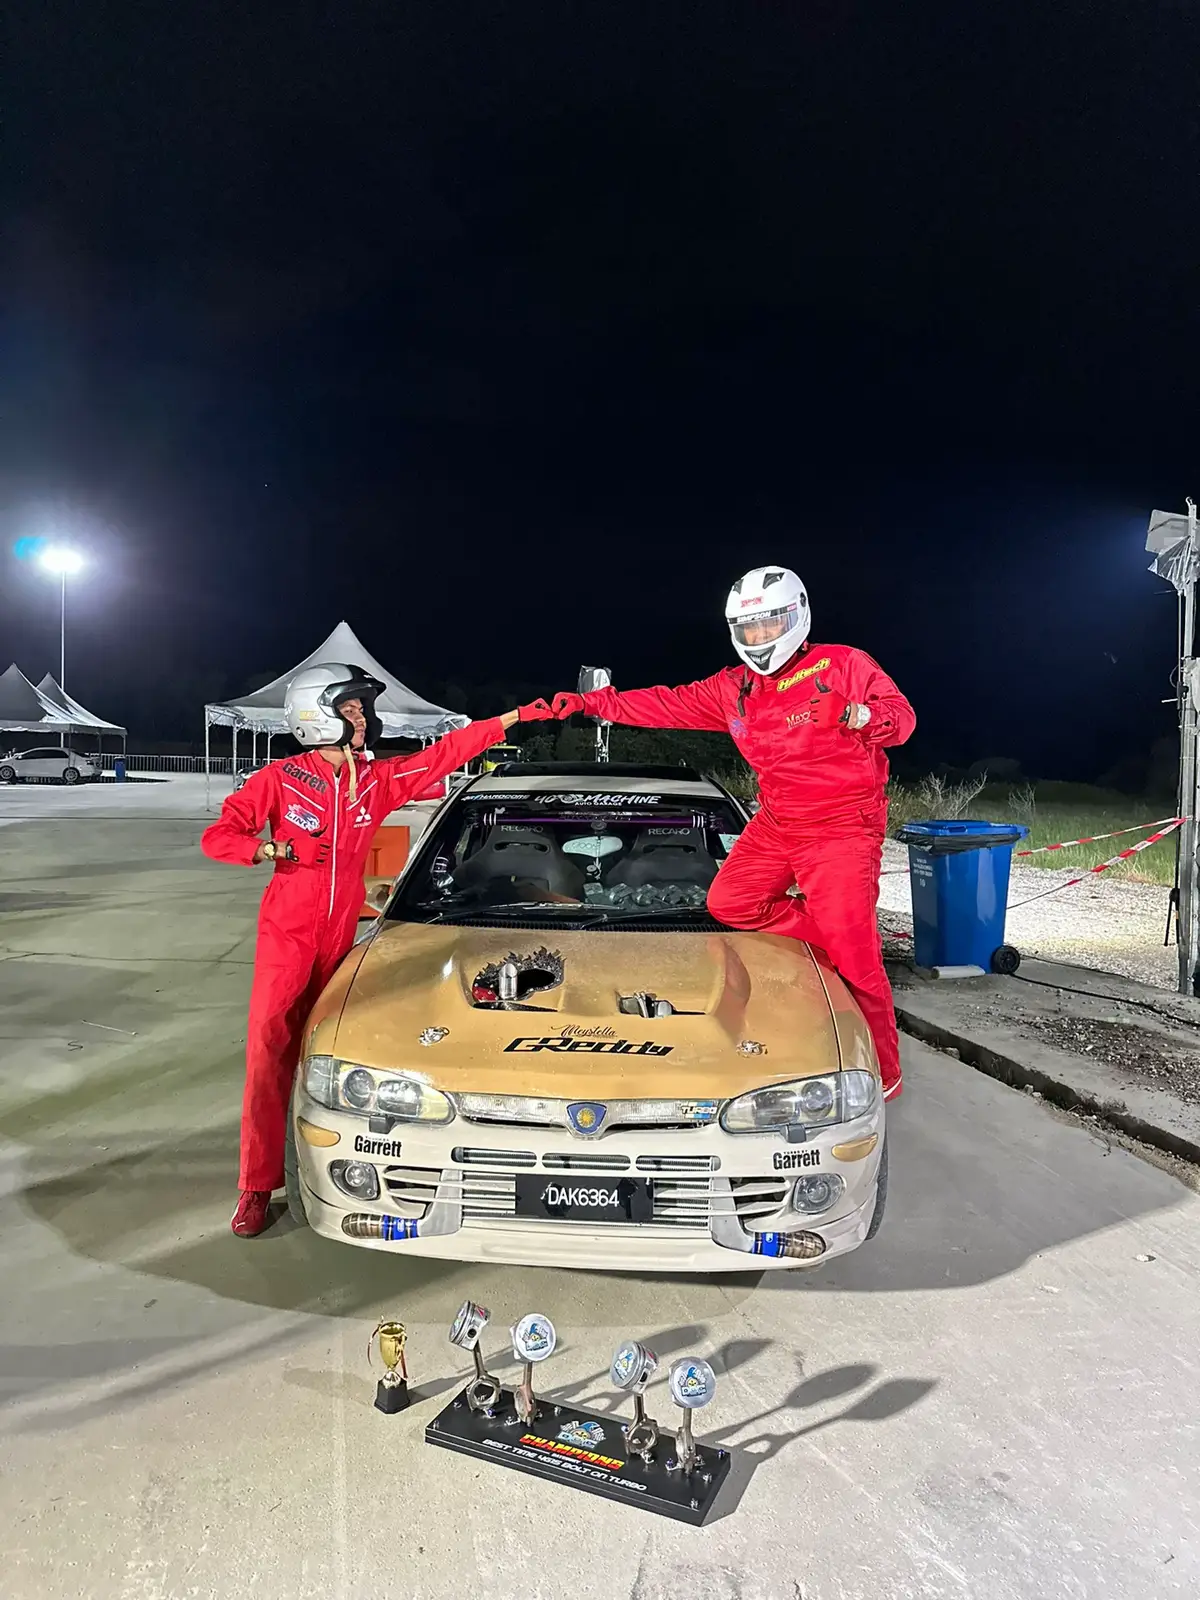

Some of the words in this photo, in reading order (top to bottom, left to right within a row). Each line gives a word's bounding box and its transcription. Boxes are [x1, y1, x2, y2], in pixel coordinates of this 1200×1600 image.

[737, 611, 771, 622] SIMPSON
[584, 793, 661, 804] MACHINE
[501, 825, 544, 833] RECARO
[648, 827, 690, 835] RECARO
[551, 1024, 637, 1038] Meystella
[503, 1037, 675, 1056] GReddy
[681, 1106, 718, 1114] TURBO
[354, 1135, 402, 1157] Garrett
[773, 1149, 820, 1170] Garrett
[547, 1187, 620, 1207] DAK6364
[519, 1433, 625, 1471] CHAMPIONS
[482, 1438, 512, 1450] BEST
[512, 1446, 538, 1459] TIME
[561, 1461, 591, 1474] BOLT
[609, 1475, 648, 1491] TURBO
